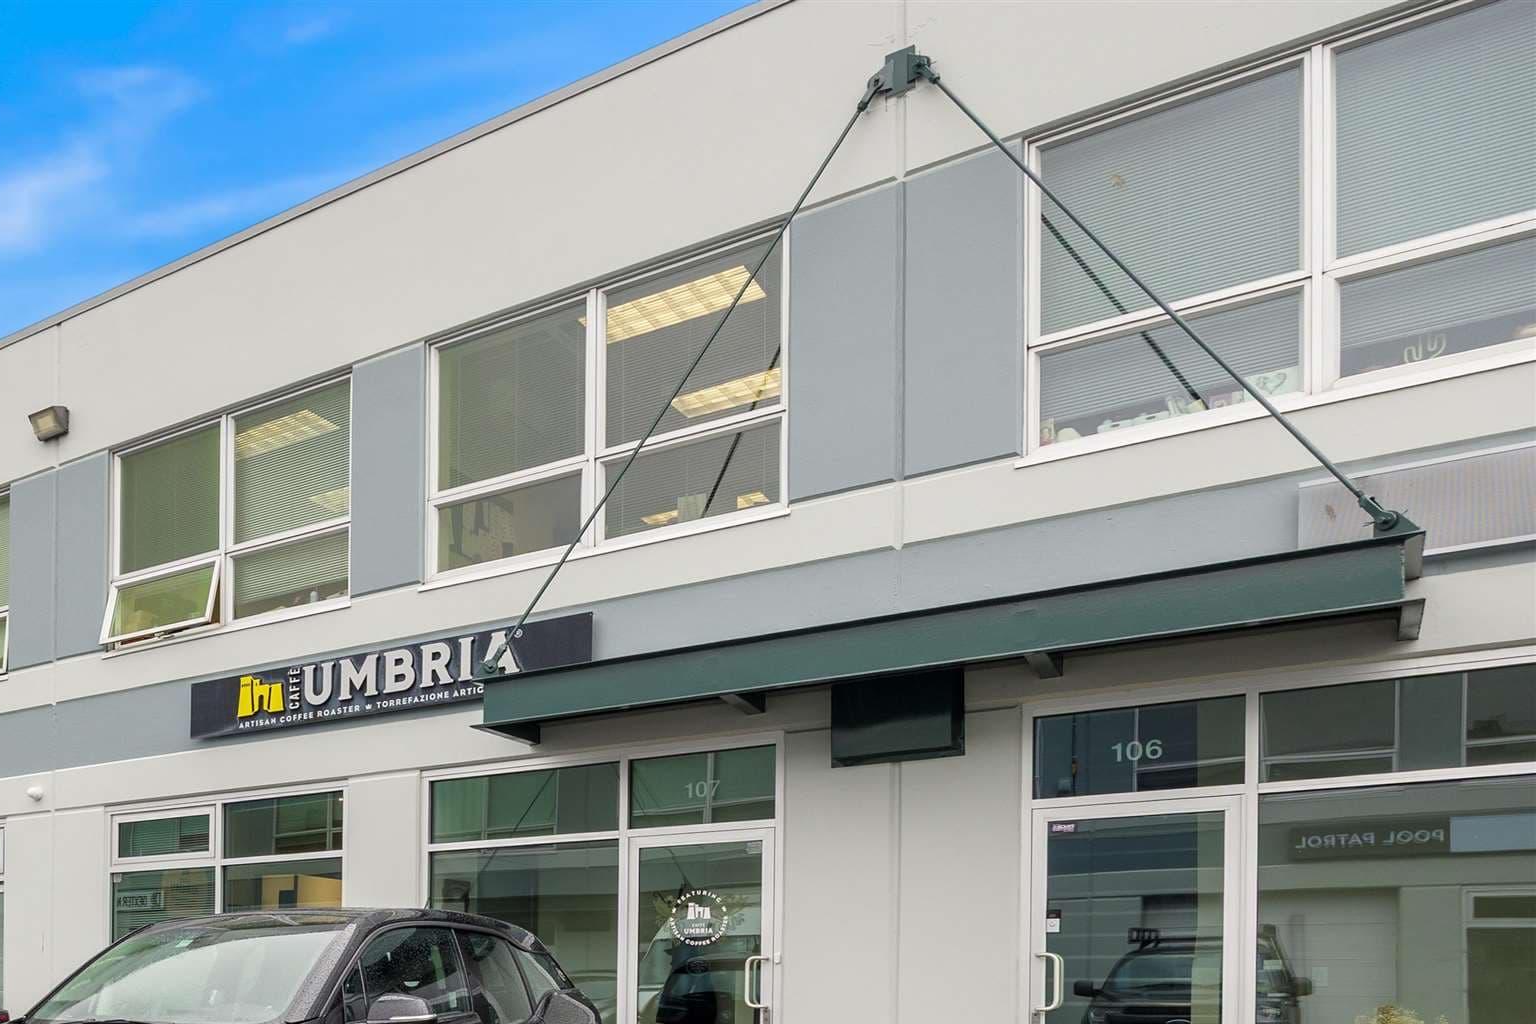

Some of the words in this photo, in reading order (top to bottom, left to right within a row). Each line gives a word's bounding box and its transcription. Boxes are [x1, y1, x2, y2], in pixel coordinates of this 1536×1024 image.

[303, 631, 520, 705] UMBRIA
[238, 717, 276, 729] ARTISAN
[280, 711, 314, 724] COFFEE
[317, 704, 361, 718] ROASTER
[376, 691, 450, 710] TORREFAZIONE
[1111, 739, 1163, 762] 106
[684, 780, 721, 799] 107
[683, 927, 714, 935] UMBRIA
